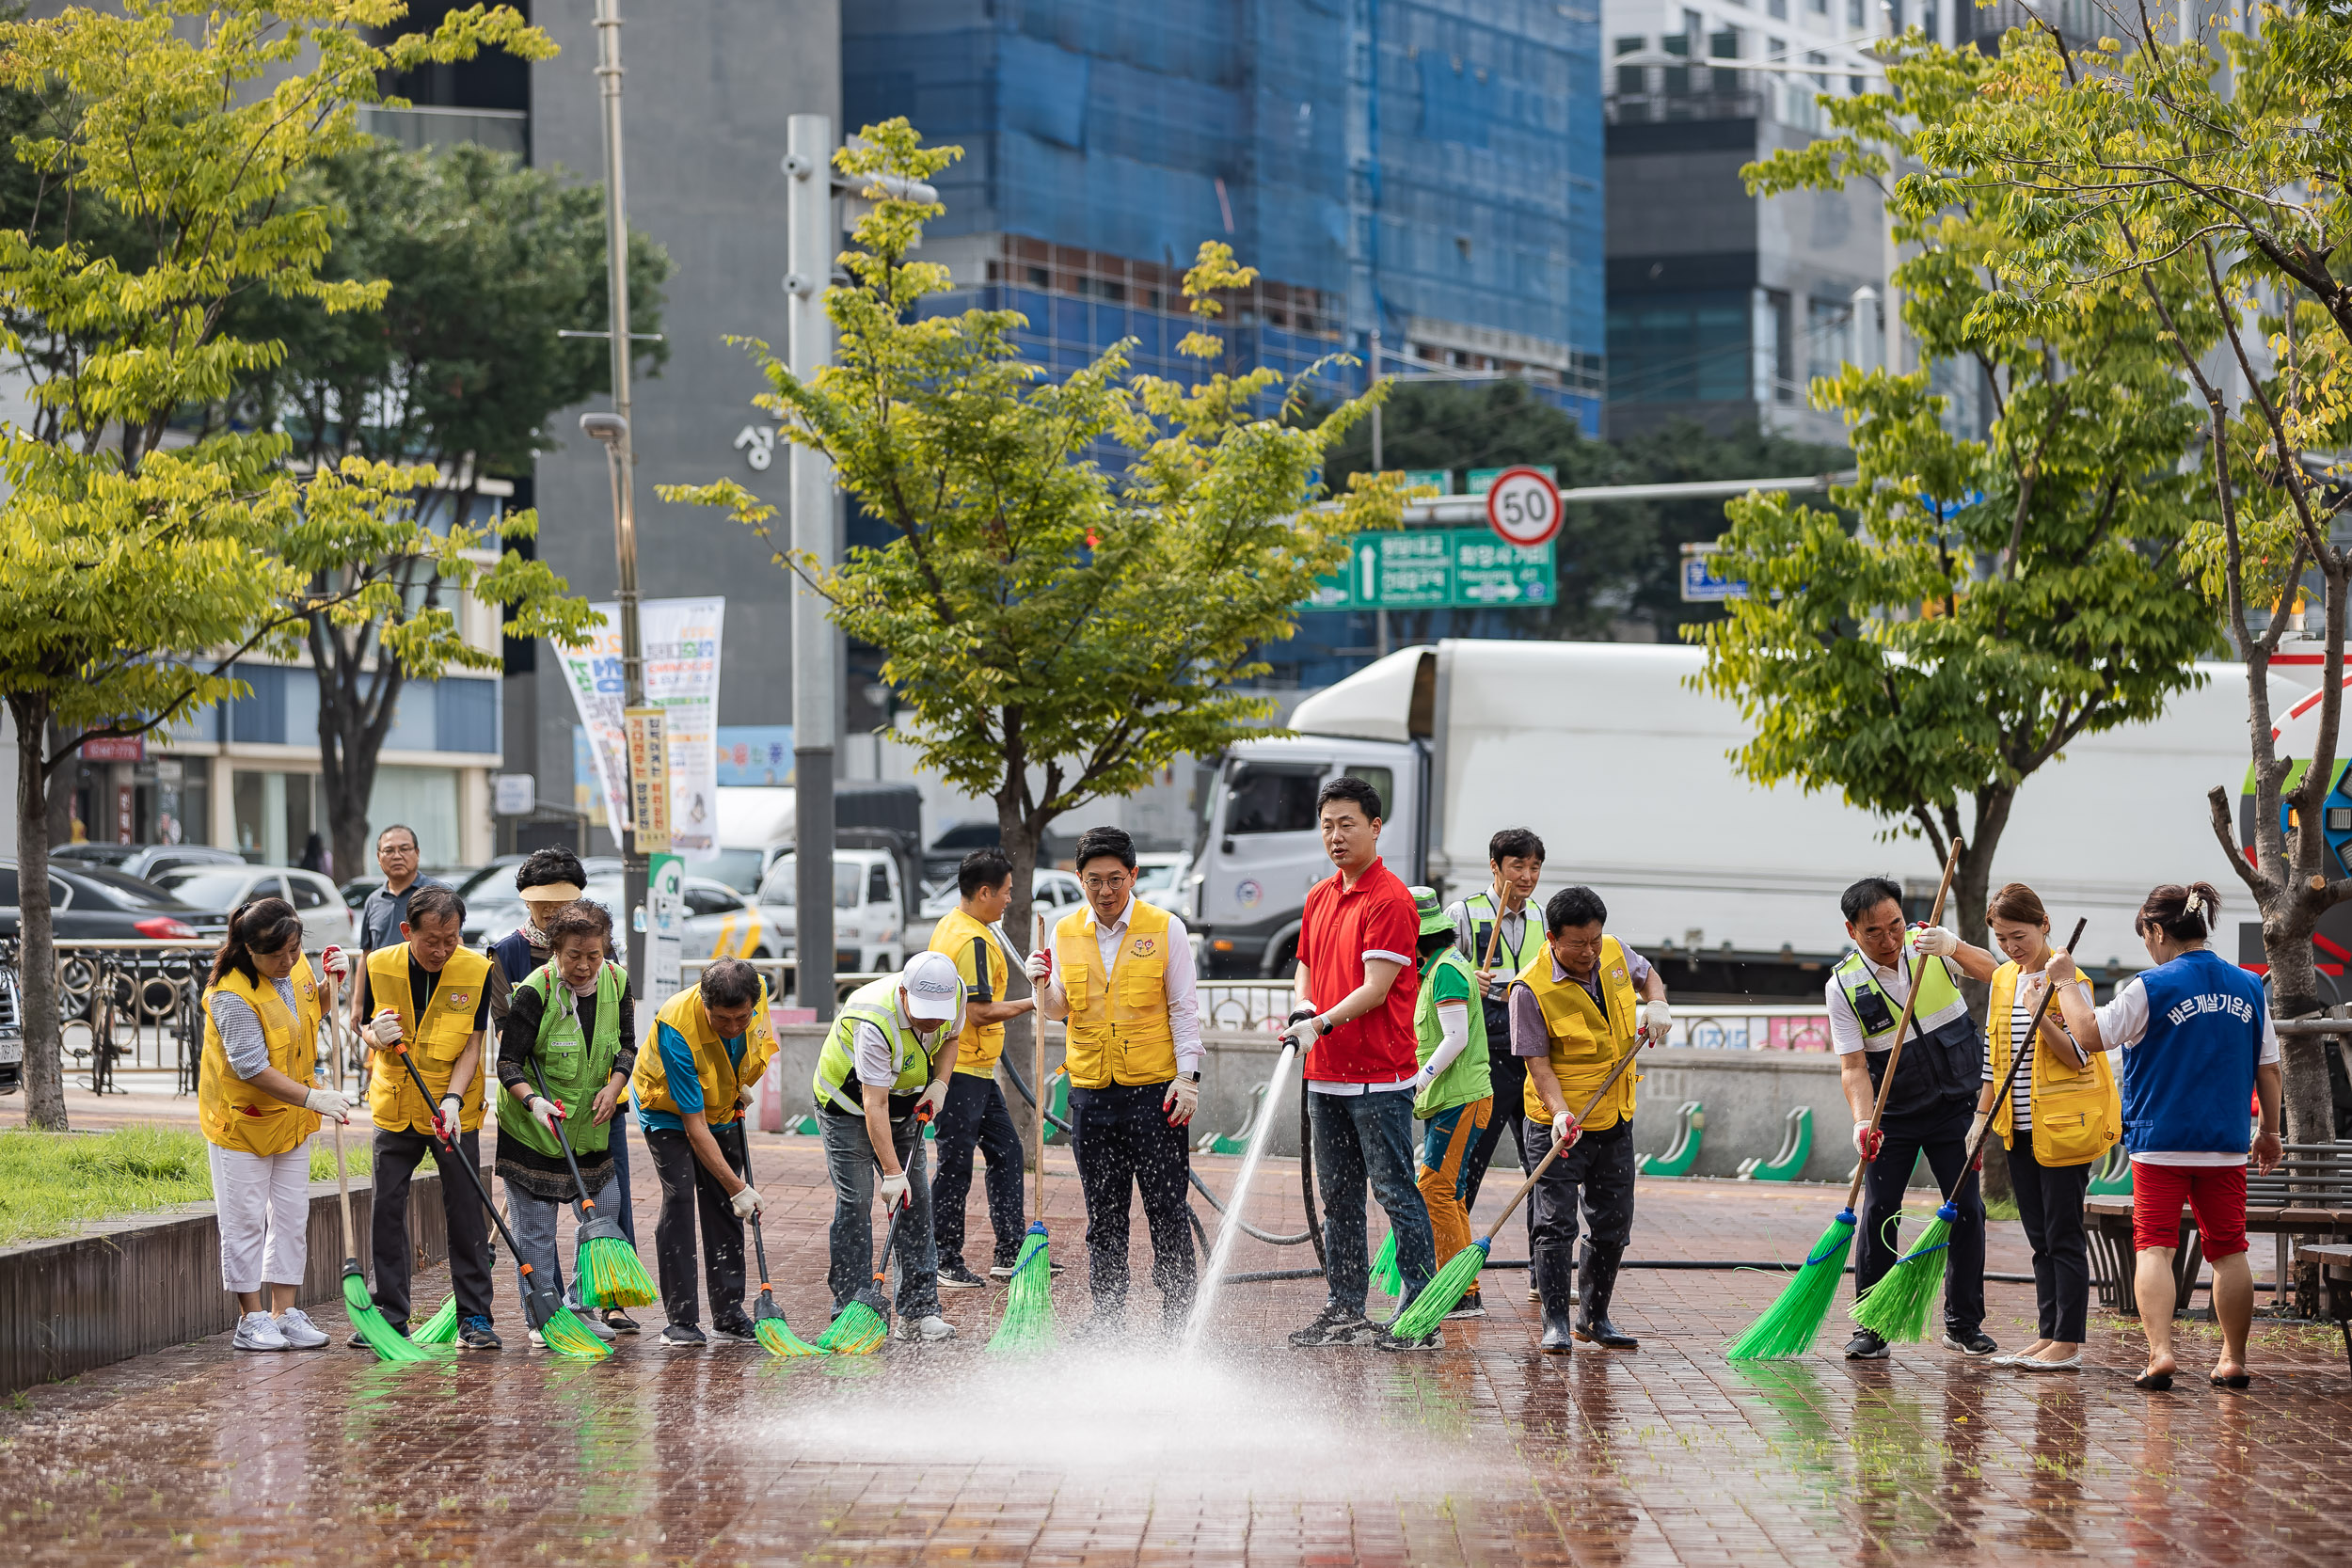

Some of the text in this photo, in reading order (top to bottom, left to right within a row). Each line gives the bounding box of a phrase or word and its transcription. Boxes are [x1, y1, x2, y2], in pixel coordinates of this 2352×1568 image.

[1504, 488, 1547, 525] 50
[915, 979, 955, 993] Titleist
[2167, 993, 2253, 1026] 바르게살기운동
